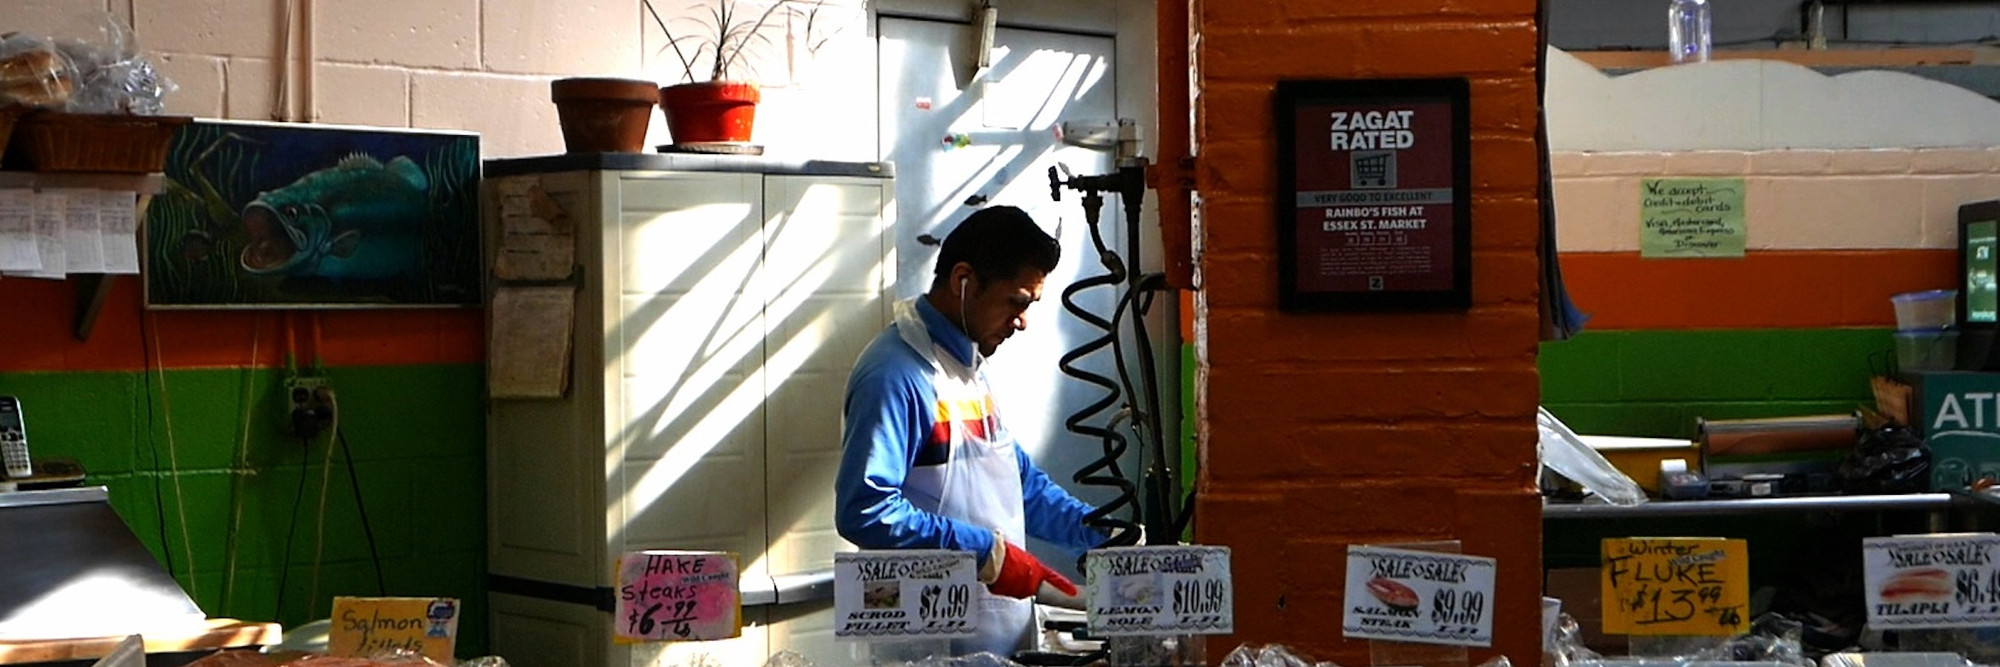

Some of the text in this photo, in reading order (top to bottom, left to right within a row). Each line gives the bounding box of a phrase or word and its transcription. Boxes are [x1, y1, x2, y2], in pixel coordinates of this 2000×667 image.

[1331, 110, 1414, 130] ZAGAT
[1330, 130, 1415, 151] RATED
[1646, 179, 1707, 196] We accept
[1314, 191, 1433, 203] VERY GOOD TO EXCELLENT
[1325, 206, 1424, 218] RAINBO'S FISH AT
[1695, 202, 1731, 213] cards
[1323, 219, 1427, 231] ESSEX ST. MARKET
[1932, 391, 2000, 430] AT
[1629, 541, 1700, 555] Winter
[1945, 546, 1983, 565] SALE
[645, 555, 706, 577] HAKE
[863, 562, 898, 580] SALE
[1115, 557, 1150, 576] SALE
[1376, 559, 1460, 583] SALE SALE
[1609, 555, 1724, 588] FLUKE
[919, 584, 969, 622] $7.99
[1173, 579, 1223, 617] $10.99
[1431, 588, 1483, 625] $9.99
[848, 610, 906, 620] SCROD
[1097, 606, 1163, 615] LEMON
[1352, 606, 1421, 618] SALMON
[1877, 603, 1949, 615] TILAPIA
[342, 608, 424, 635] Salmon
[843, 621, 911, 631] FILLET
[1107, 617, 1153, 625] SOLE
[1361, 618, 1412, 628] STEAK
